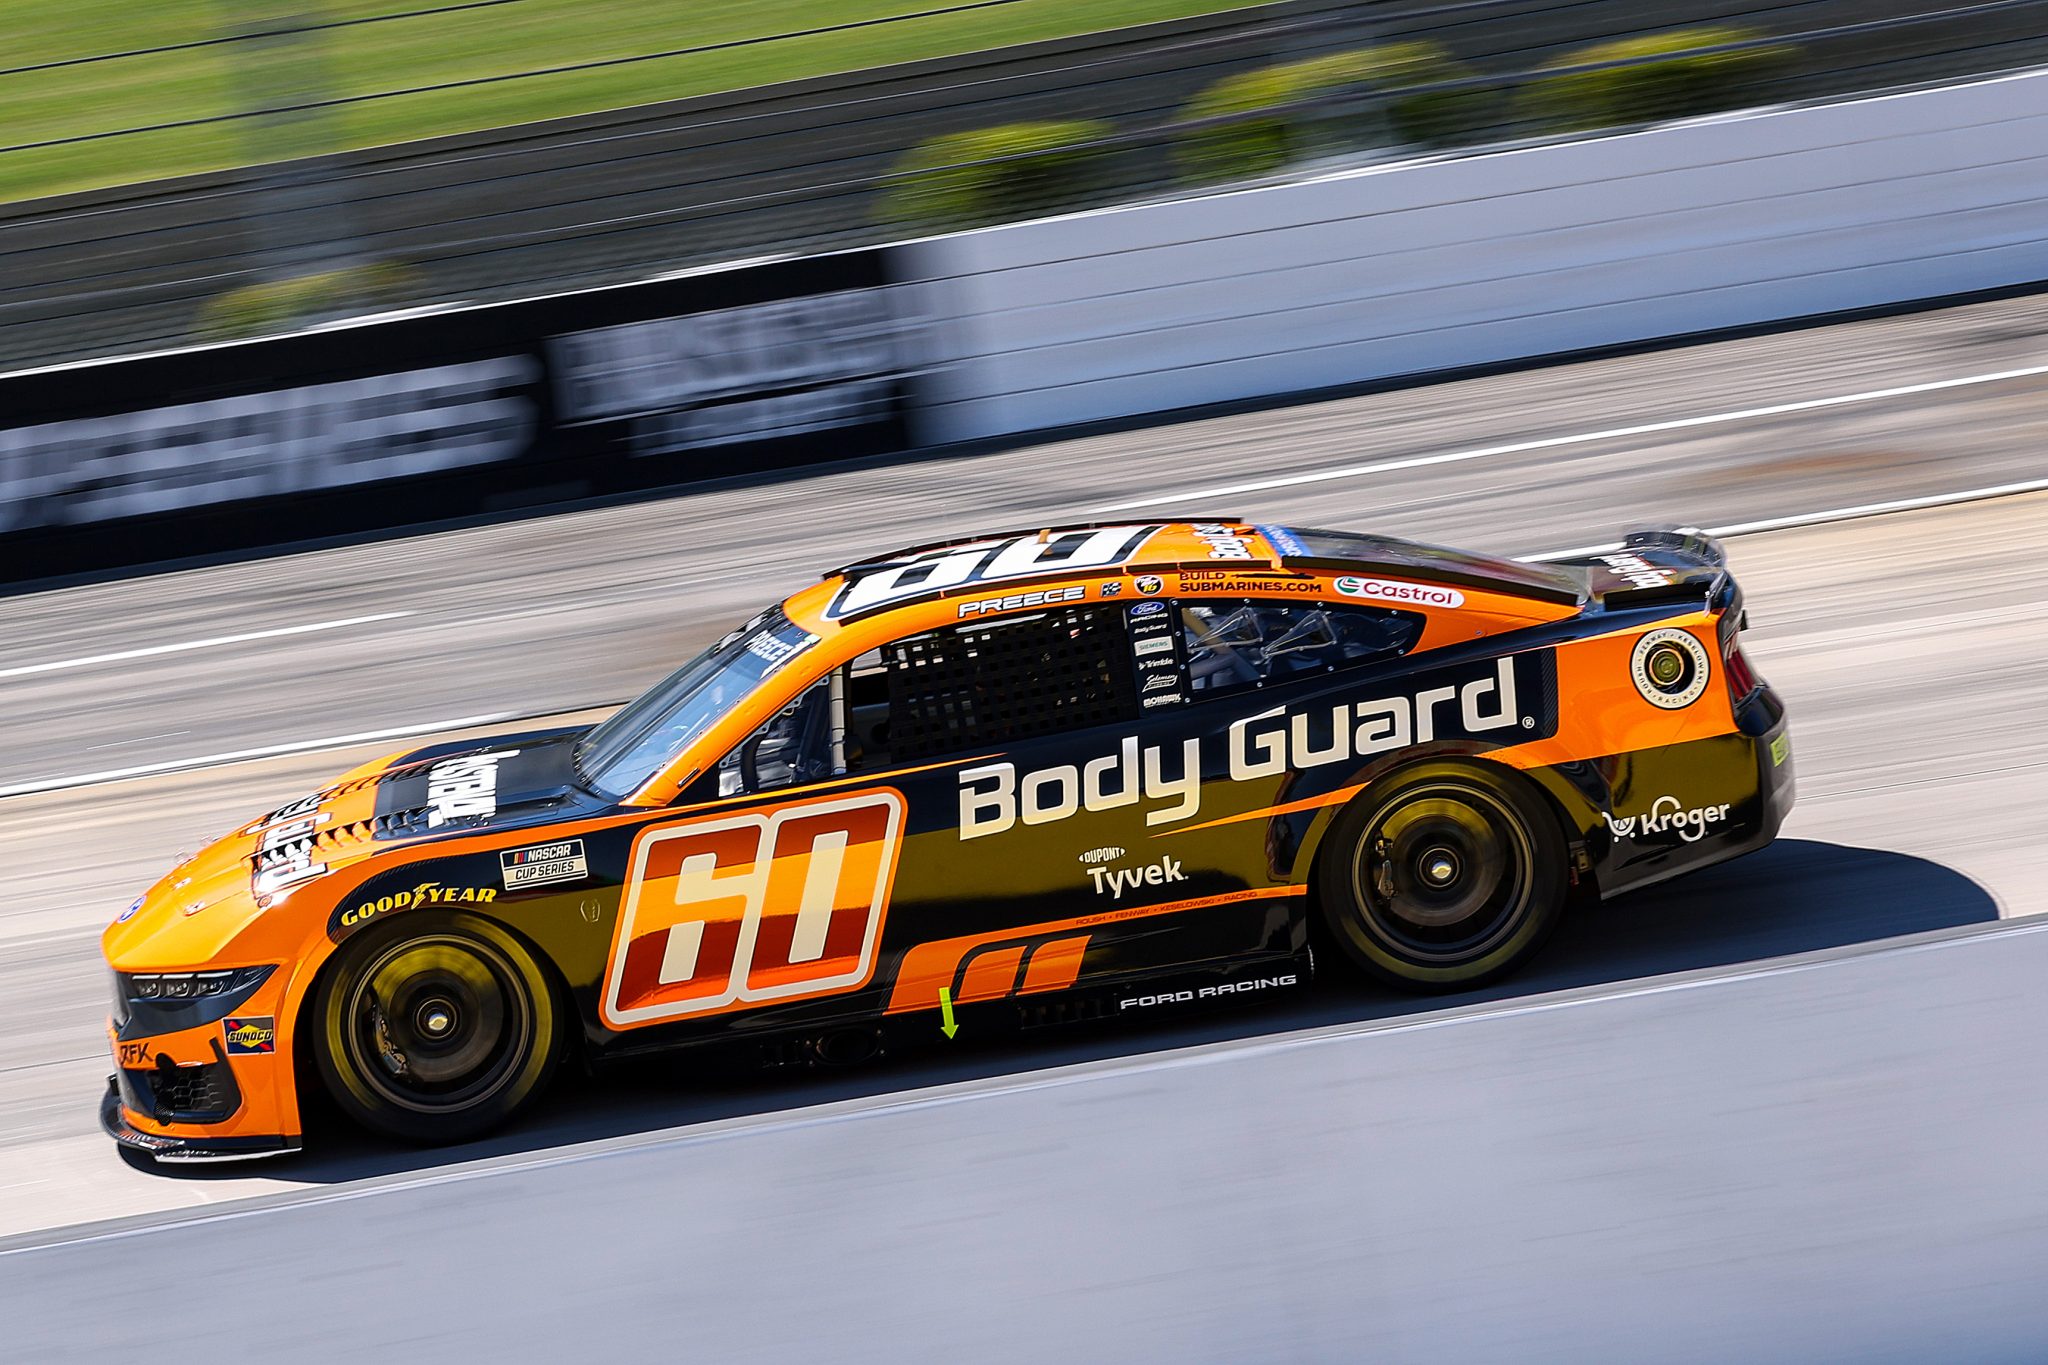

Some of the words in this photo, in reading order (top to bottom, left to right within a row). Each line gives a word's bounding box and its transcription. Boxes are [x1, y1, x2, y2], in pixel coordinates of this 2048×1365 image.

[1180, 572, 1226, 581] BUILD
[1180, 581, 1323, 593] SUBMARINES.COM
[1363, 582, 1453, 604] Castrol
[957, 585, 1086, 619] PREECE
[1137, 602, 1158, 613] Ford
[743, 629, 796, 662] PREECE
[1139, 641, 1169, 651] SIEMENS
[1145, 658, 1174, 668] Trimble
[958, 736, 1201, 841] Body
[1640, 795, 1731, 843] Kroger
[528, 844, 572, 862] NASCAR
[1083, 846, 1120, 864] DUPONT
[515, 868, 537, 880] CUP
[538, 861, 575, 877] SERIES
[1086, 855, 1185, 899] Tyvek
[605, 792, 901, 1025] 60
[1075, 915, 1107, 926] ROUSH
[1115, 908, 1150, 920] FENWAY
[1160, 897, 1215, 912] KESELOWSKI
[1224, 891, 1258, 903] RACING
[1120, 991, 1194, 1010] FORD
[1199, 974, 1297, 999] RACING
[229, 1030, 272, 1043] SUNOCO
